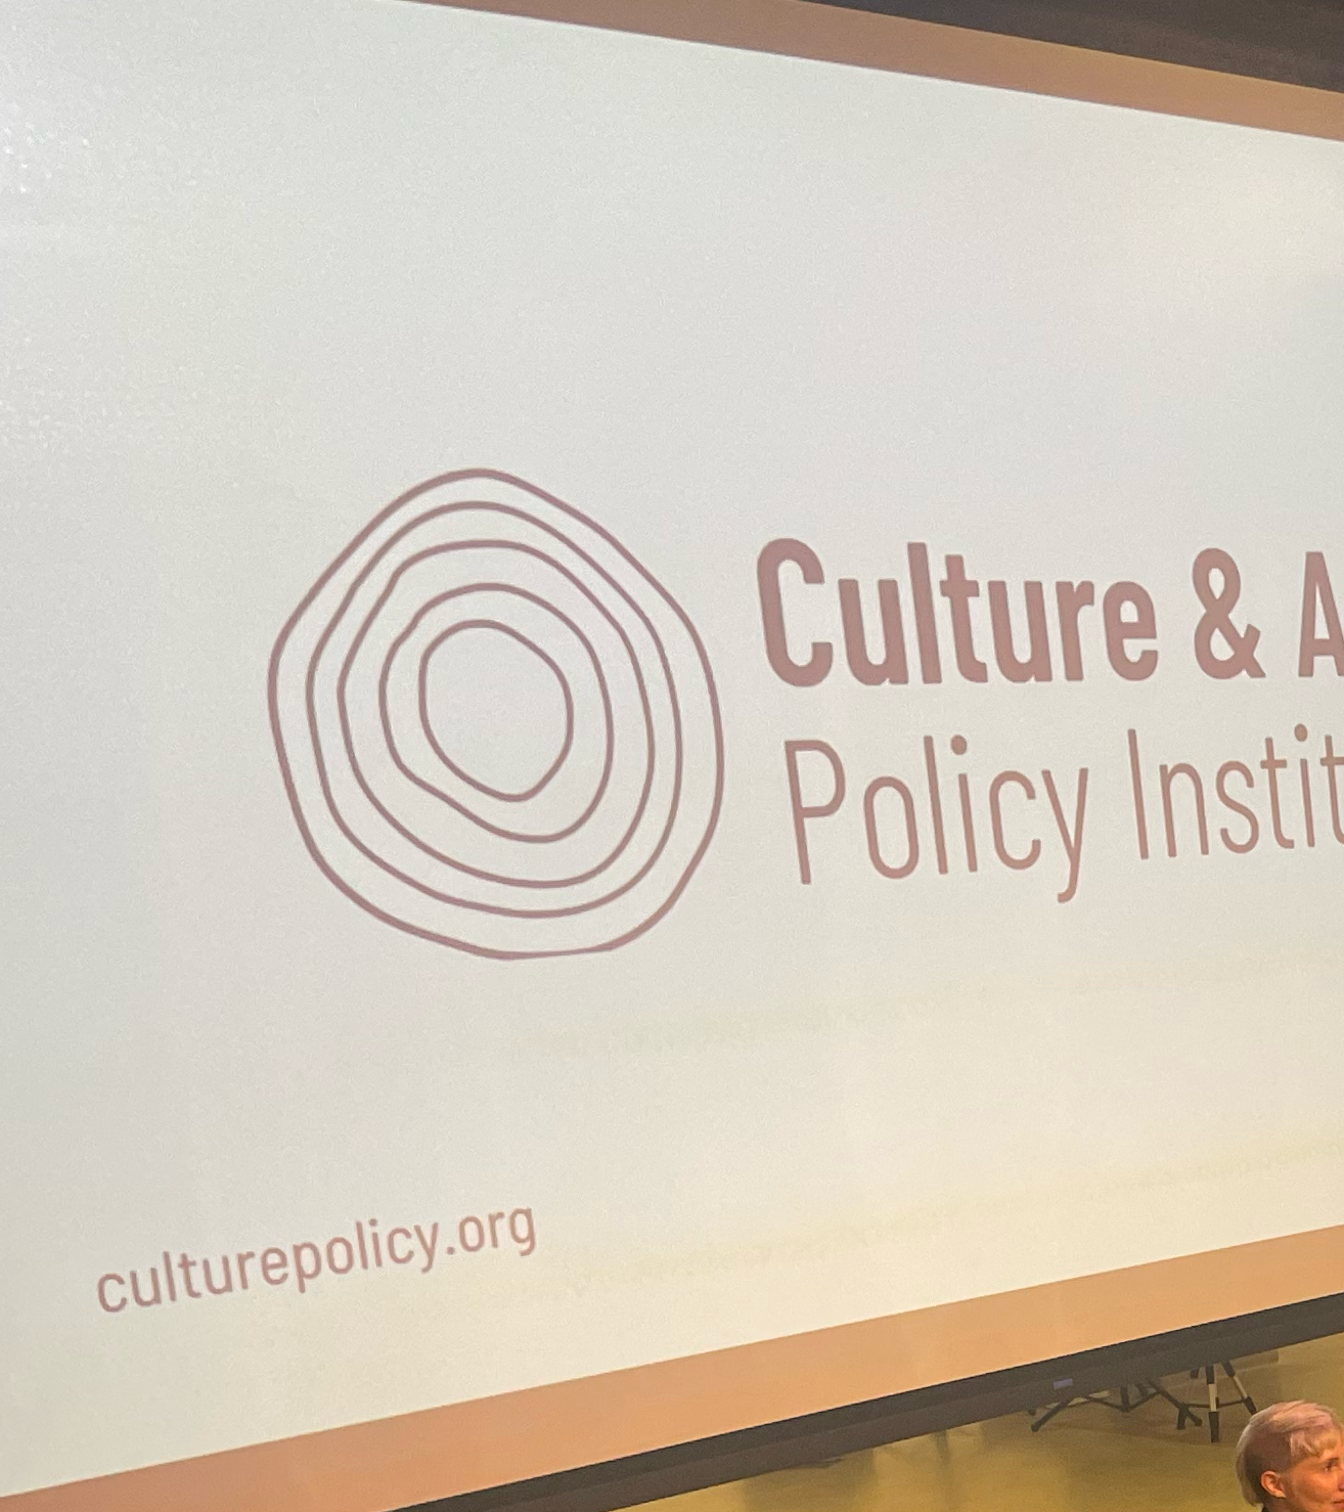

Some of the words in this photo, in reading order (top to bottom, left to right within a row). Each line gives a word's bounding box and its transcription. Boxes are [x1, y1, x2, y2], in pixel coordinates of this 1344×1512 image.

[755, 536, 1160, 687] Culture
[1192, 547, 1266, 680] &
[784, 733, 1089, 903] Policy
[96, 1206, 537, 1314] culturepolicy.org
